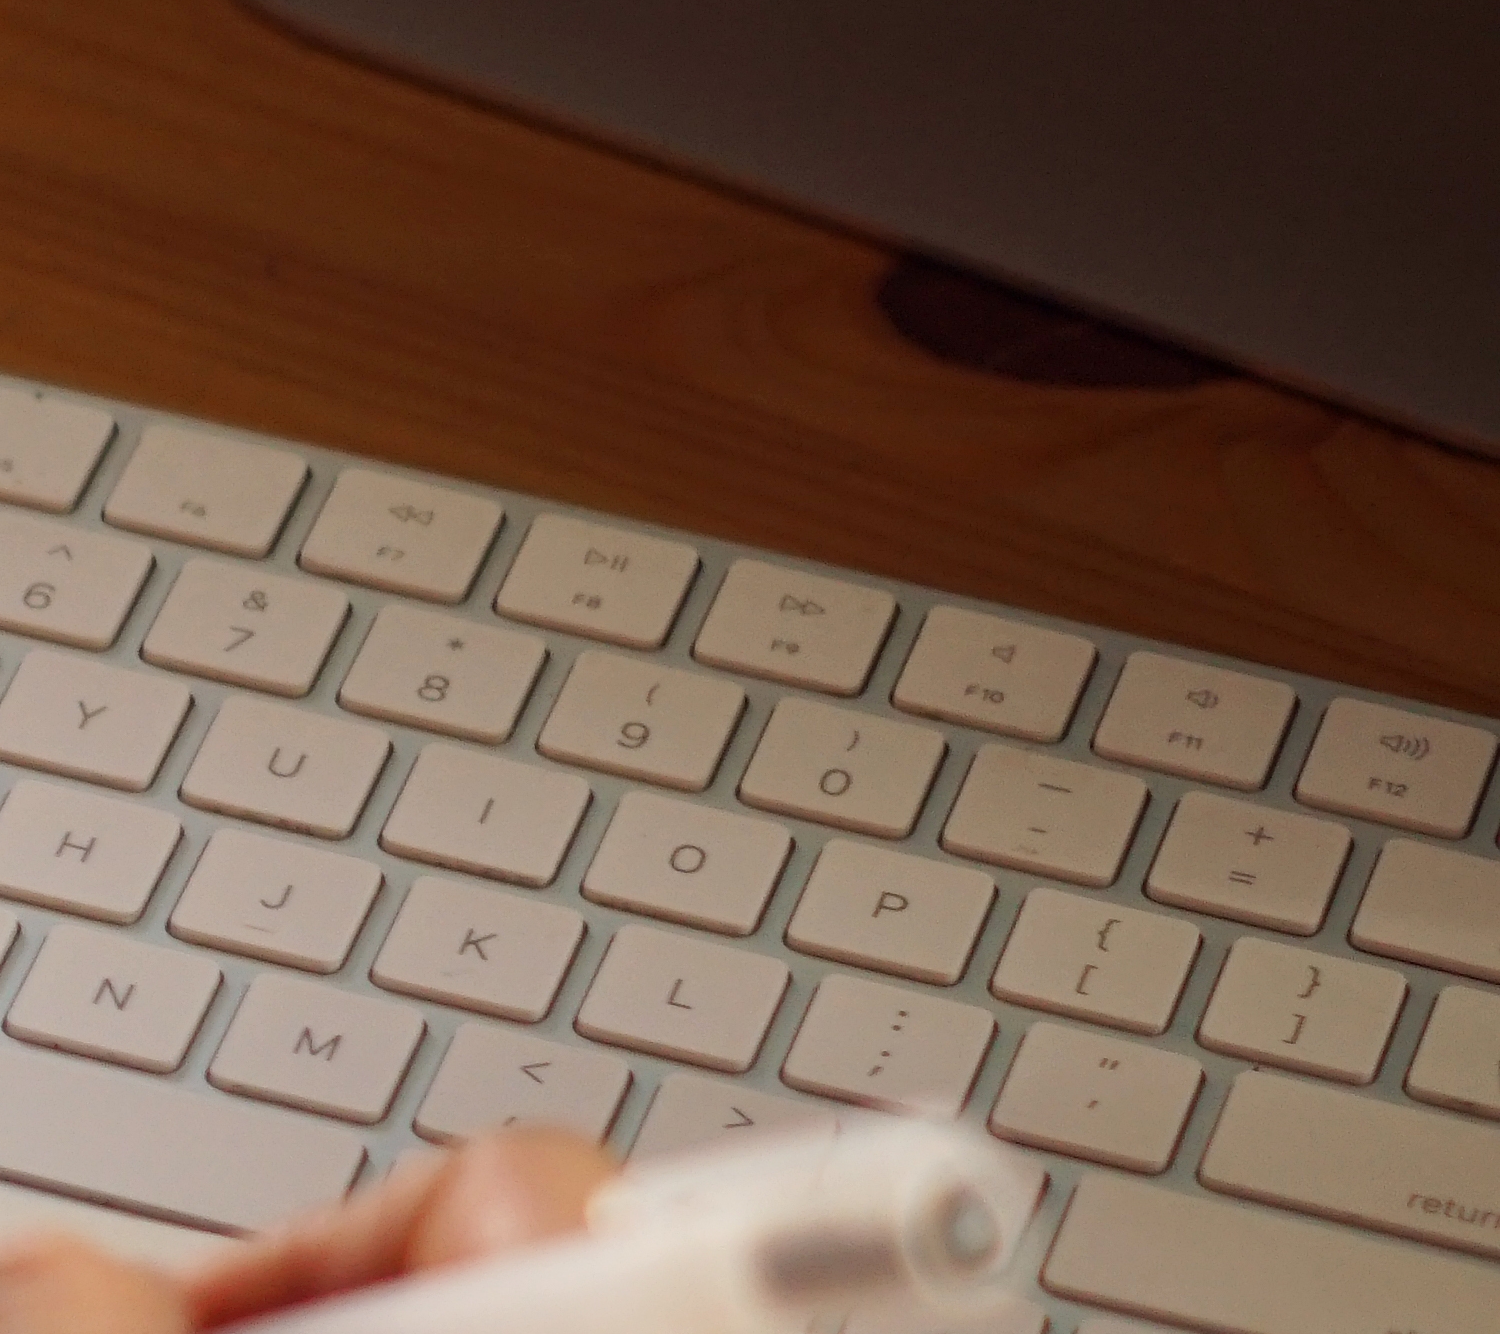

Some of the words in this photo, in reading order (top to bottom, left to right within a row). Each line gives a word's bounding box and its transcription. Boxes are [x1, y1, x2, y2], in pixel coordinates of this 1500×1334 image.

[22, 581, 56, 610] 6
[242, 590, 269, 613] &
[224, 626, 256, 652] 7
[770, 638, 801, 656] F9
[416, 674, 451, 703] 8
[964, 684, 1006, 705] F10
[78, 700, 107, 730] Y
[617, 721, 651, 750] 9
[1167, 730, 1204, 750] F11
[266, 747, 308, 779] U
[818, 767, 853, 797] 0
[1367, 776, 1409, 798] F12
[478, 797, 496, 825] I
[55, 831, 97, 863] H
[668, 843, 708, 875] O
[259, 884, 294, 911] J
[872, 891, 910, 918] P
[459, 928, 496, 961] K
[93, 977, 136, 1011] N
[666, 978, 692, 1011] L
[293, 1027, 343, 1061] M
